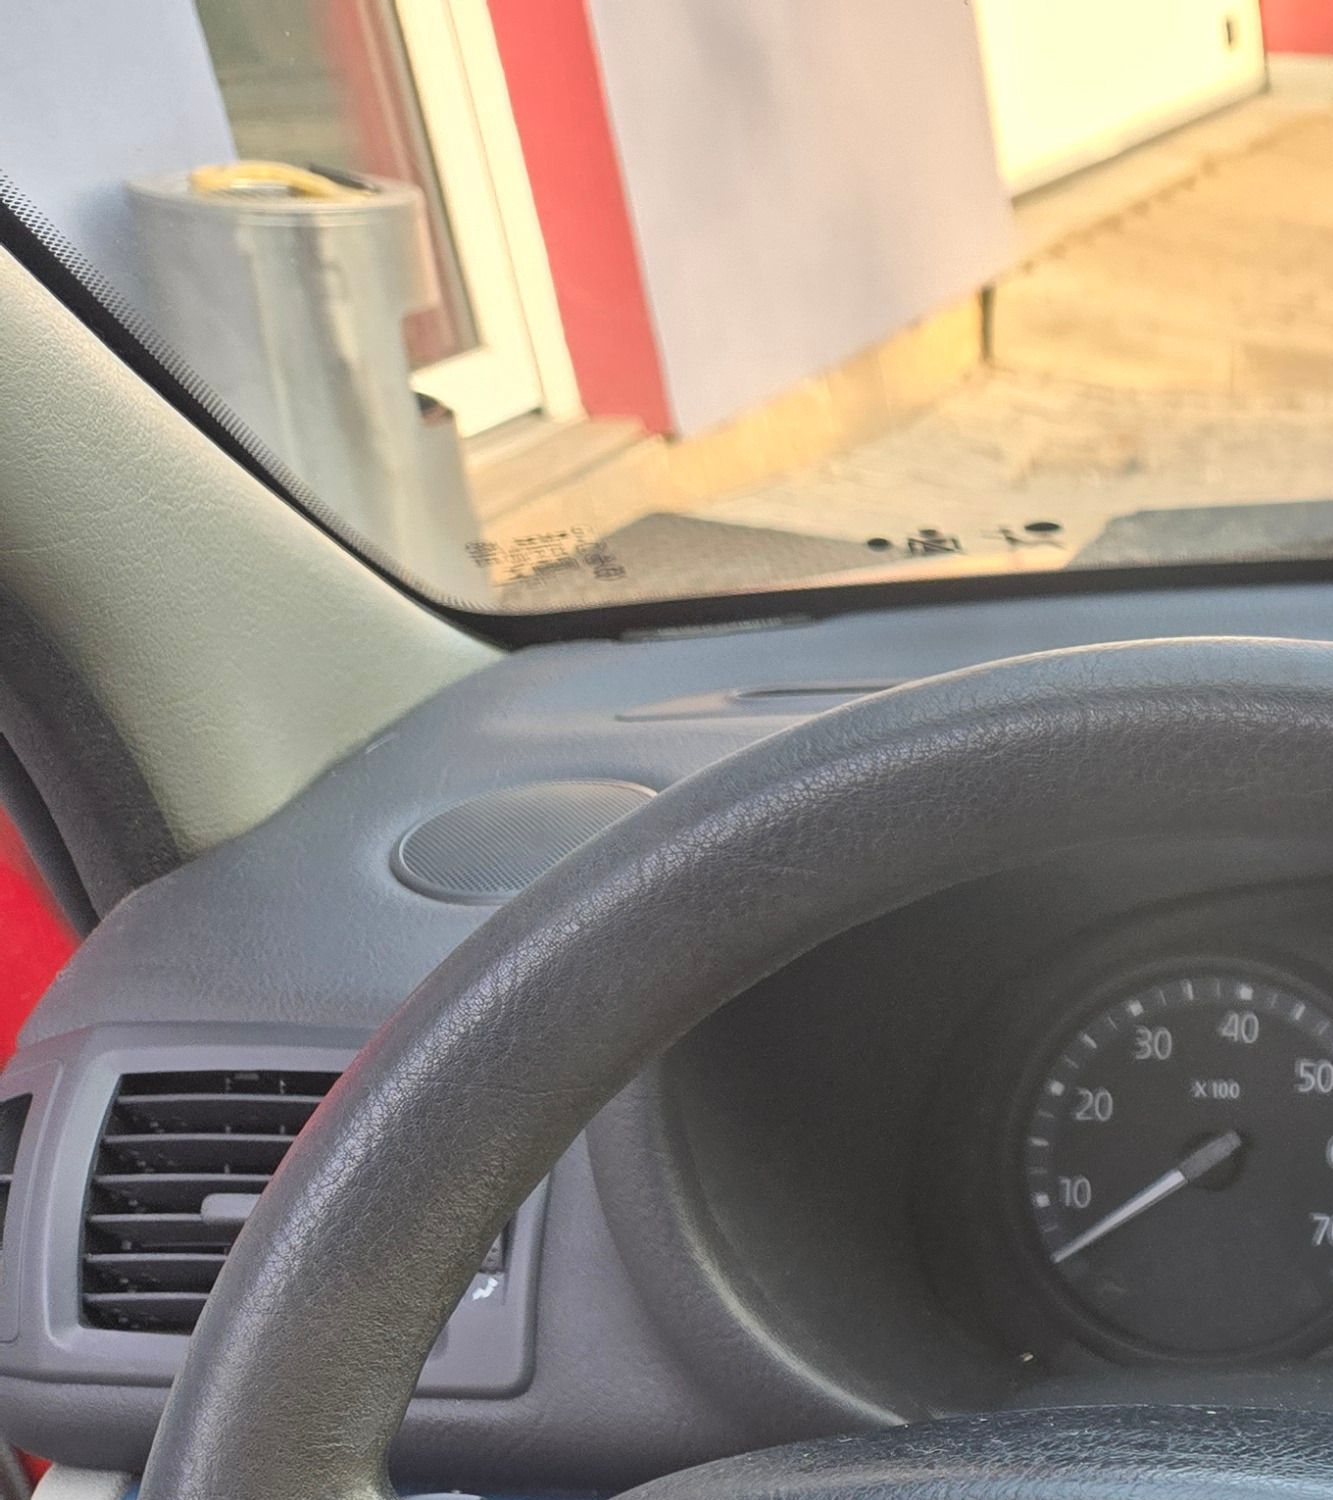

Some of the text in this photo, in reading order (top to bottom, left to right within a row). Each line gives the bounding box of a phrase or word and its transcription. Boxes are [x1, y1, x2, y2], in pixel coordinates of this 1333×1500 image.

[1134, 1026, 1173, 1060] 30
[1218, 1011, 1260, 1044] 40
[1075, 1087, 1114, 1122] 20
[1059, 1177, 1092, 1209] 10
